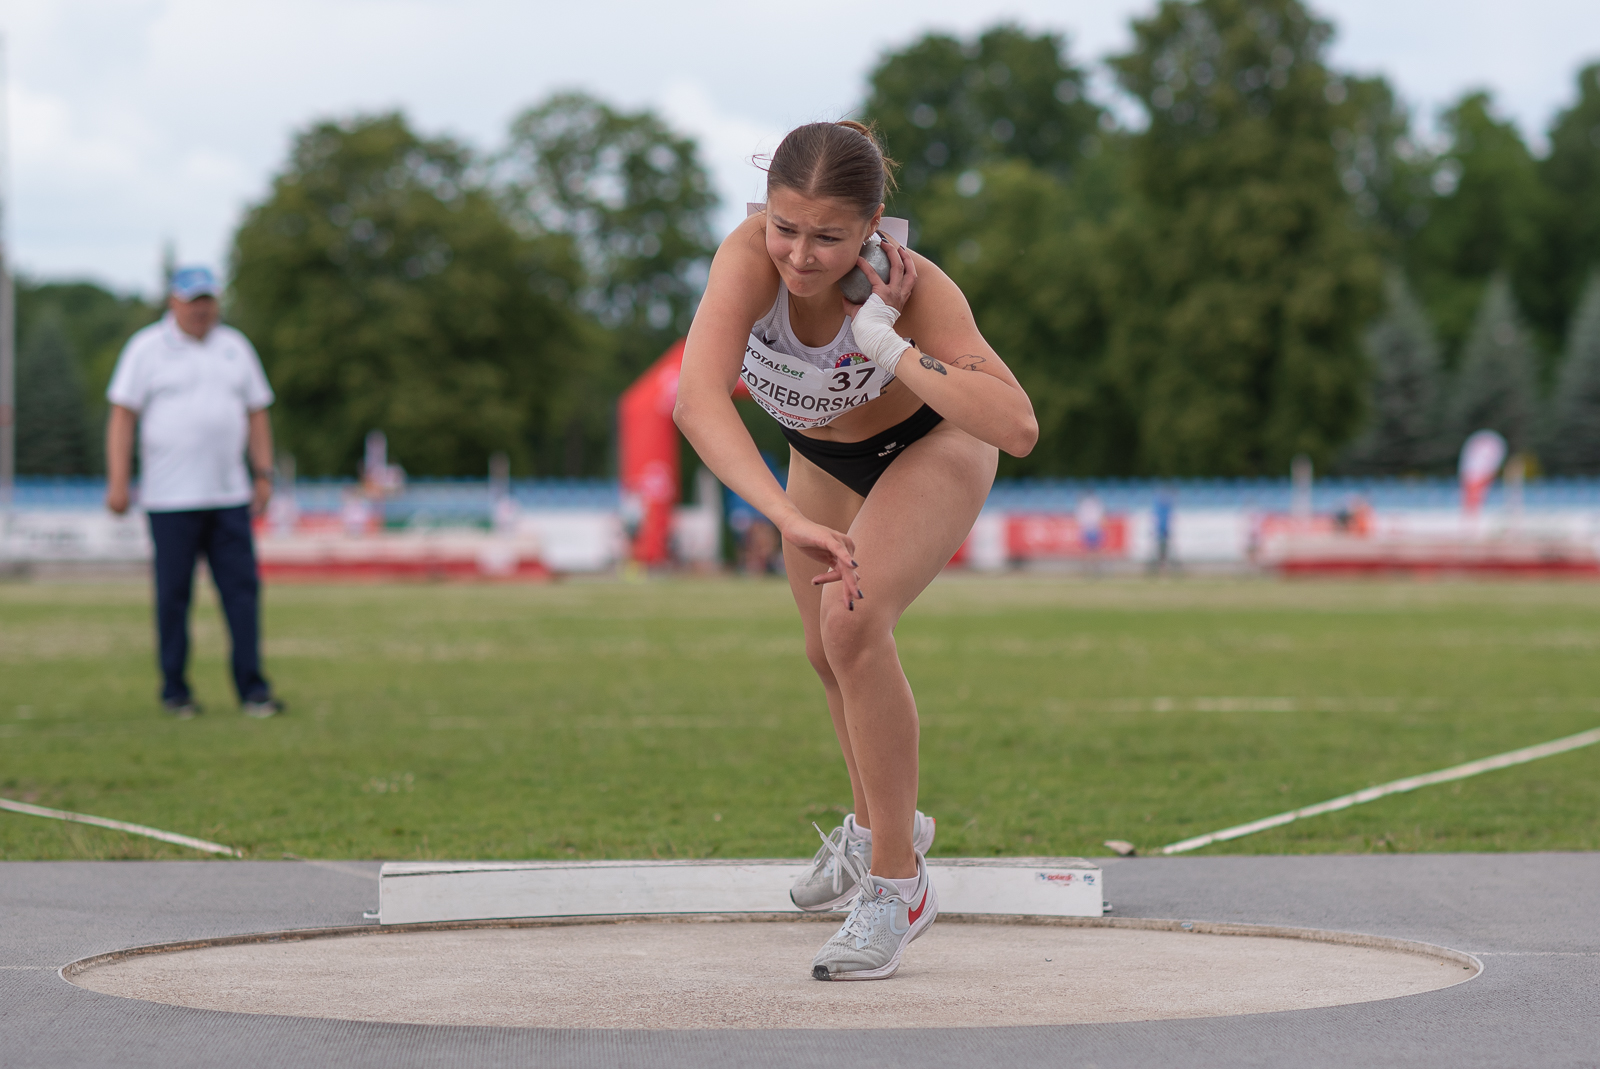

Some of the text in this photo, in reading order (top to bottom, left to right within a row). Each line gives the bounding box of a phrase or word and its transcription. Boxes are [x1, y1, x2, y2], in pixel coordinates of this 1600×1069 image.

[746, 345, 806, 379] TOTALbet
[828, 367, 876, 392] 37
[751, 393, 807, 428] ARSZAWA
